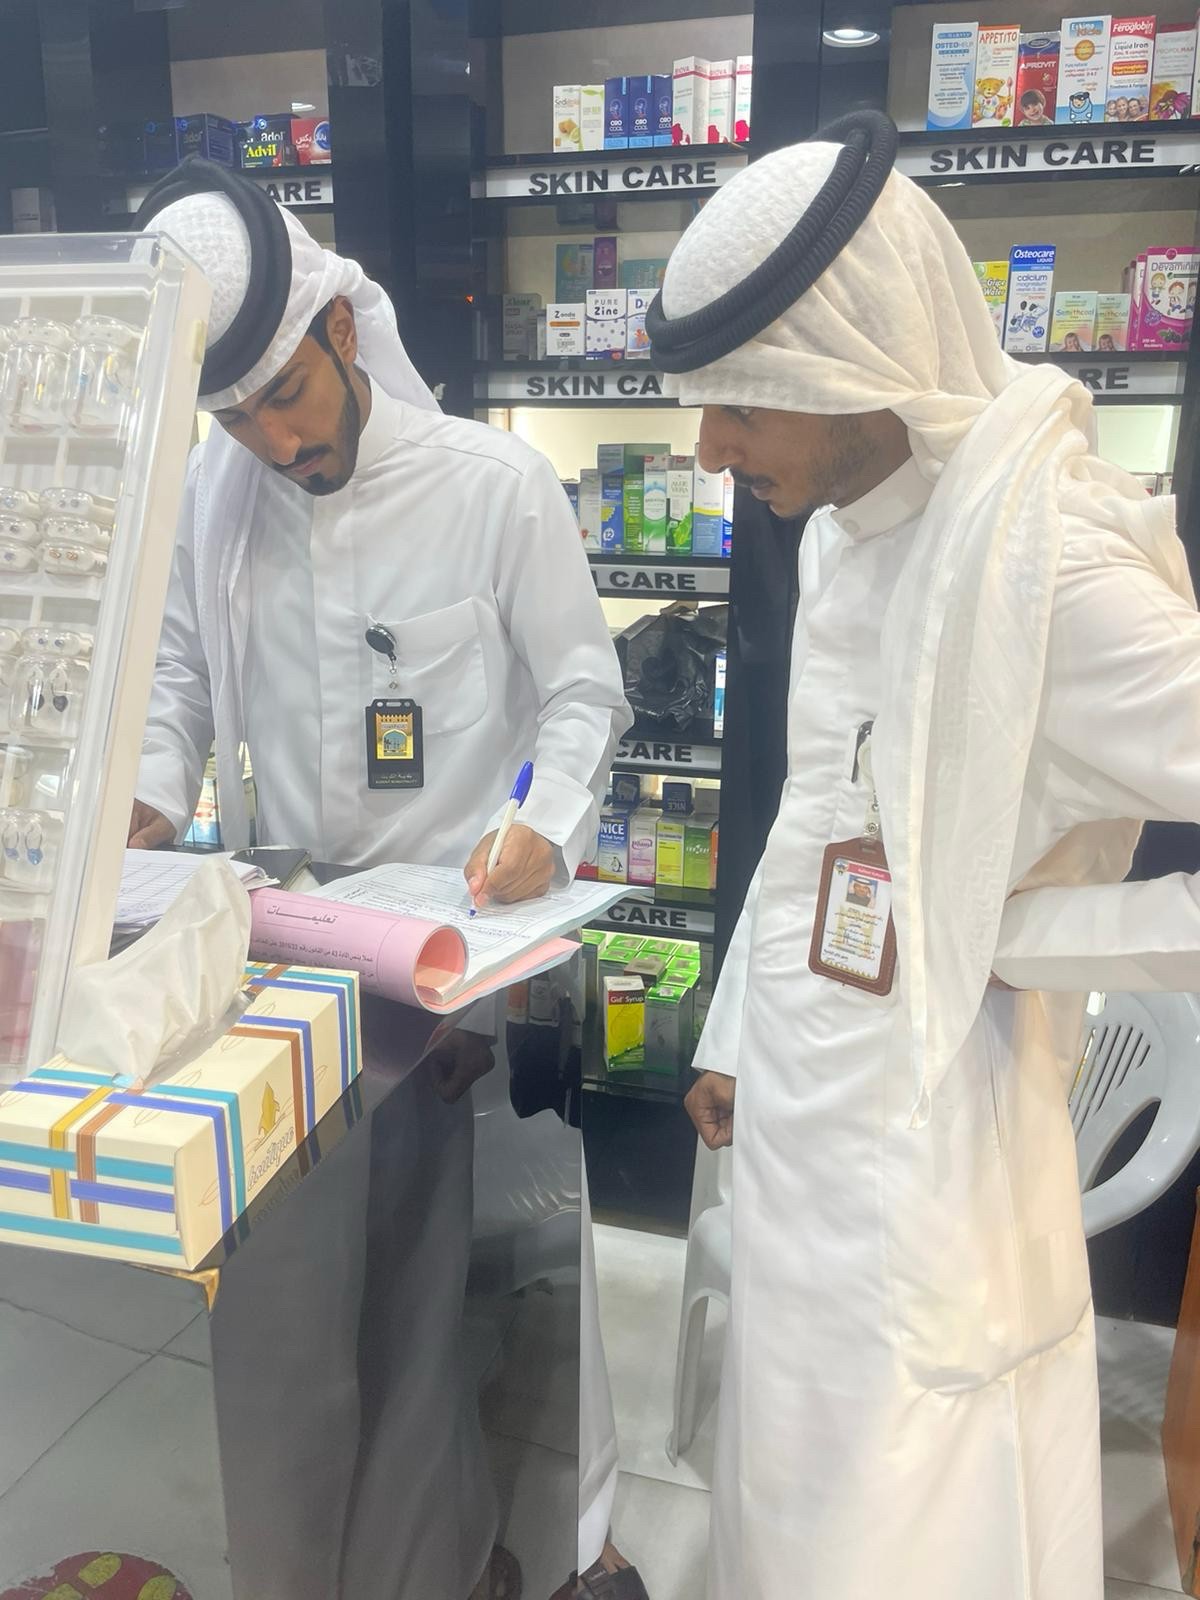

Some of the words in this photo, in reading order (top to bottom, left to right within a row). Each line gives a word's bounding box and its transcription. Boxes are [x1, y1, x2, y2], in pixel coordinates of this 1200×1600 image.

[979, 31, 1017, 44] APPETITO
[1112, 21, 1154, 33] Feroglobin
[246, 143, 277, 158] Advil
[930, 143, 1028, 172] SKIN
[1043, 139, 1156, 165] CARE
[528, 168, 608, 195] SKIN
[621, 161, 717, 189] CARE
[265, 180, 322, 202] ARE
[1014, 249, 1054, 258] Osteocare
[594, 306, 618, 316] Zinc
[526, 375, 605, 396] SKIN
[617, 374, 662, 395] CA
[1079, 367, 1129, 390] RE
[609, 570, 696, 590] CARE
[616, 741, 692, 763] CARE
[600, 822, 625, 835] NICE
[607, 906, 688, 928] CARE
